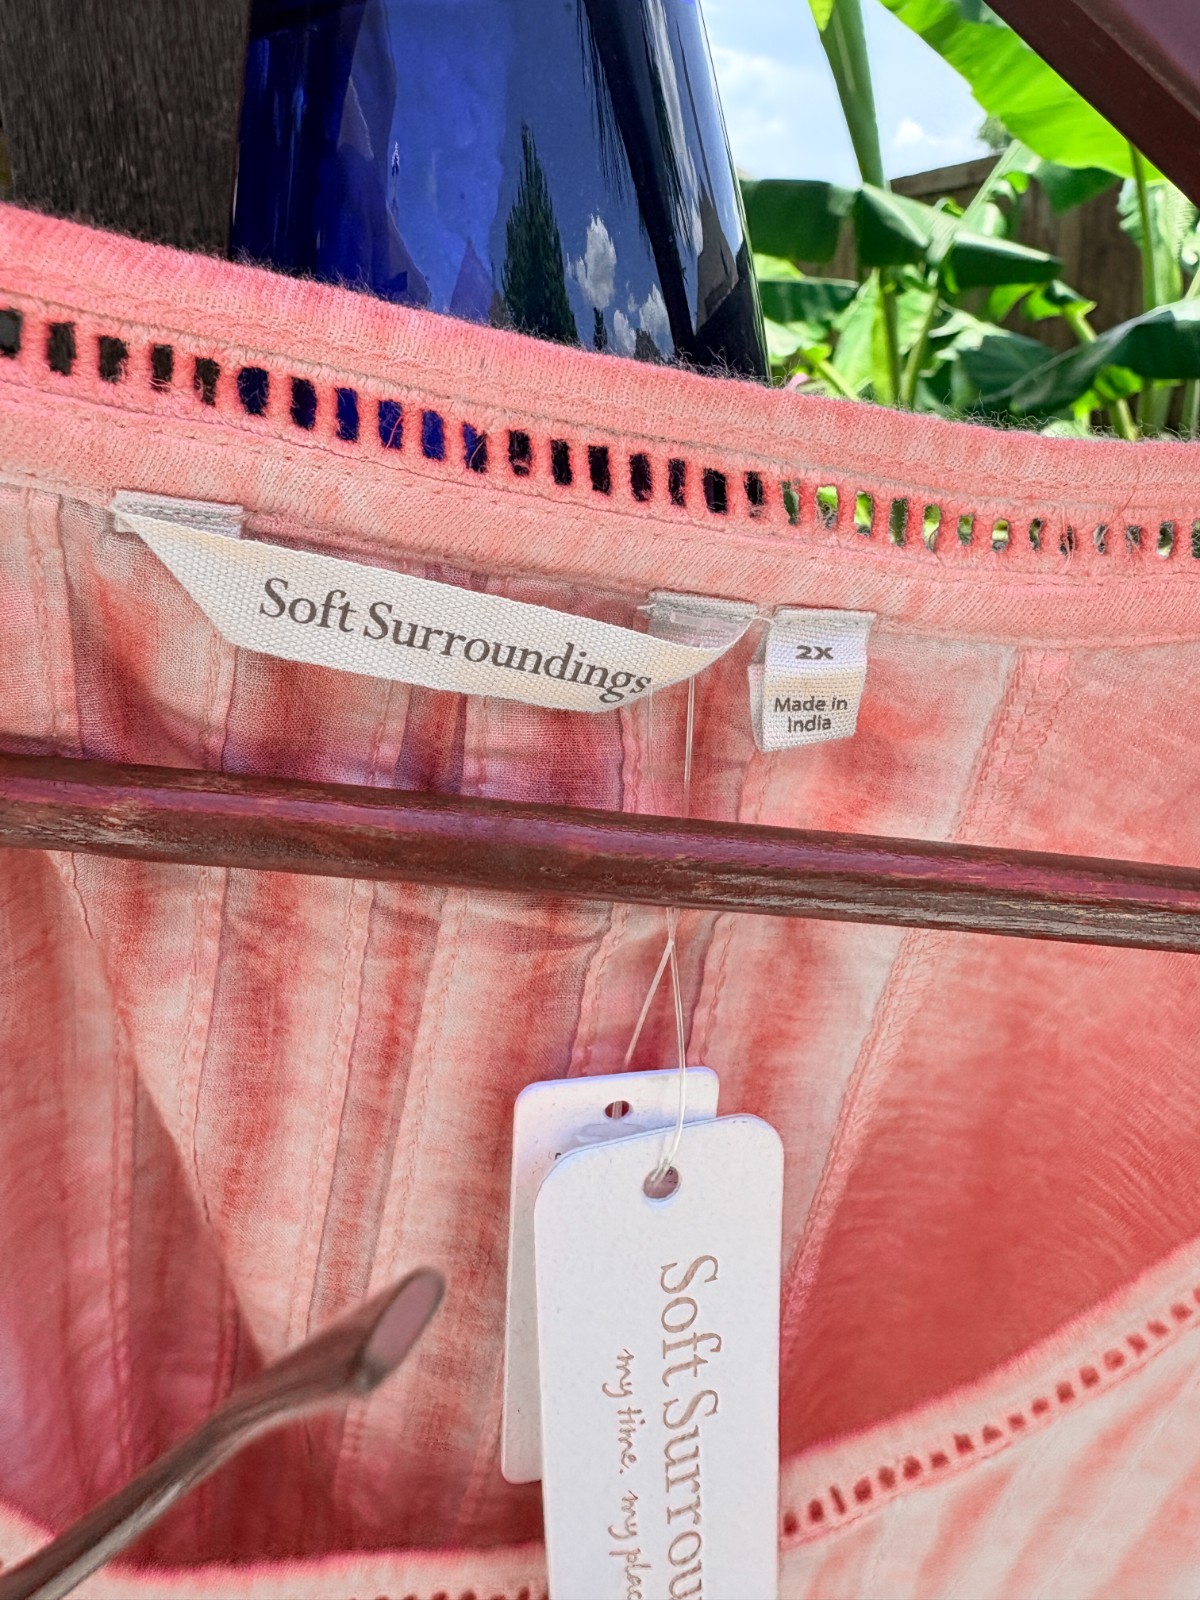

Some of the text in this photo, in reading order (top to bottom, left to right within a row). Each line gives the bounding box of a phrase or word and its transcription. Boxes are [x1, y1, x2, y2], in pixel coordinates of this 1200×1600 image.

[259, 577, 652, 704] Soft Surroundings
[795, 644, 834, 660] 2X
[774, 695, 848, 713] Made in
[787, 714, 832, 733] India
[660, 1254, 722, 1387] Soft
[602, 1348, 635, 1398] my
[616, 1406, 646, 1475] time.
[607, 1489, 639, 1540] my
